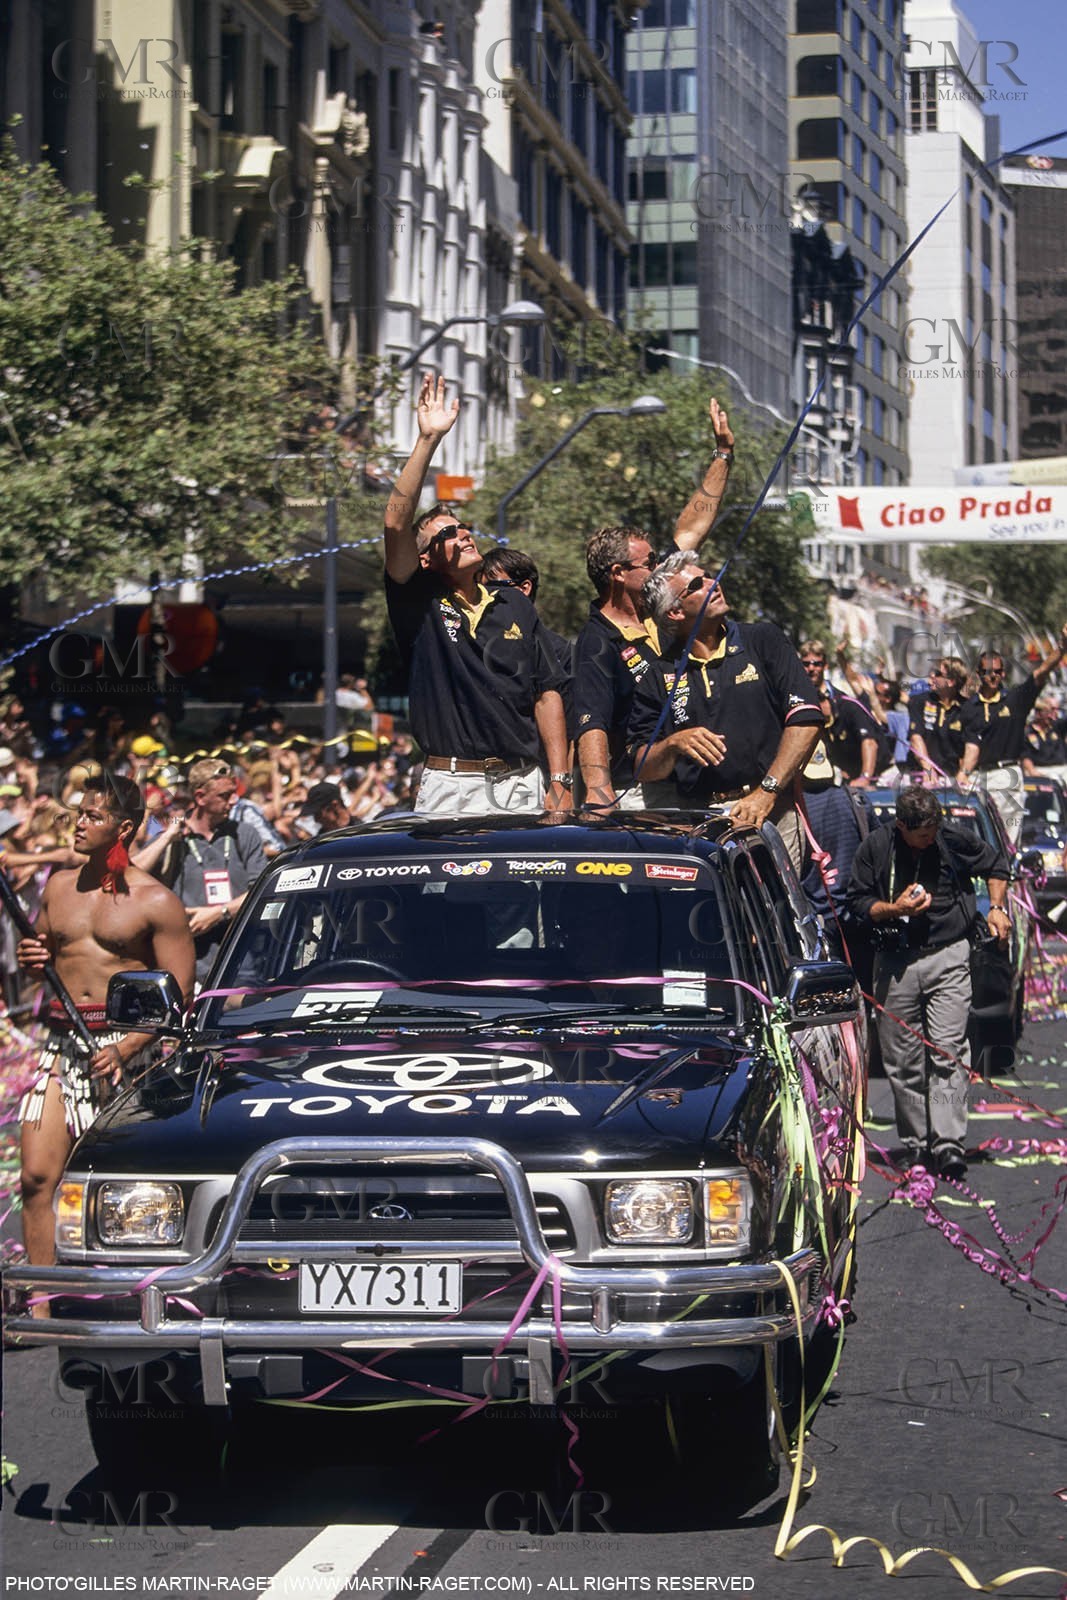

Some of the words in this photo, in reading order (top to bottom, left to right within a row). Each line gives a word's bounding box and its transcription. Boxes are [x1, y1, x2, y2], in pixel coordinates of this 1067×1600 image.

[880, 502, 946, 527] Ciao
[959, 490, 1052, 520] Prada
[364, 865, 431, 877] TOYOTA
[506, 860, 567, 873] Telecom
[575, 861, 633, 876] ONE
[241, 1095, 581, 1118] TOYOTA
[308, 1264, 450, 1306] YX7311
